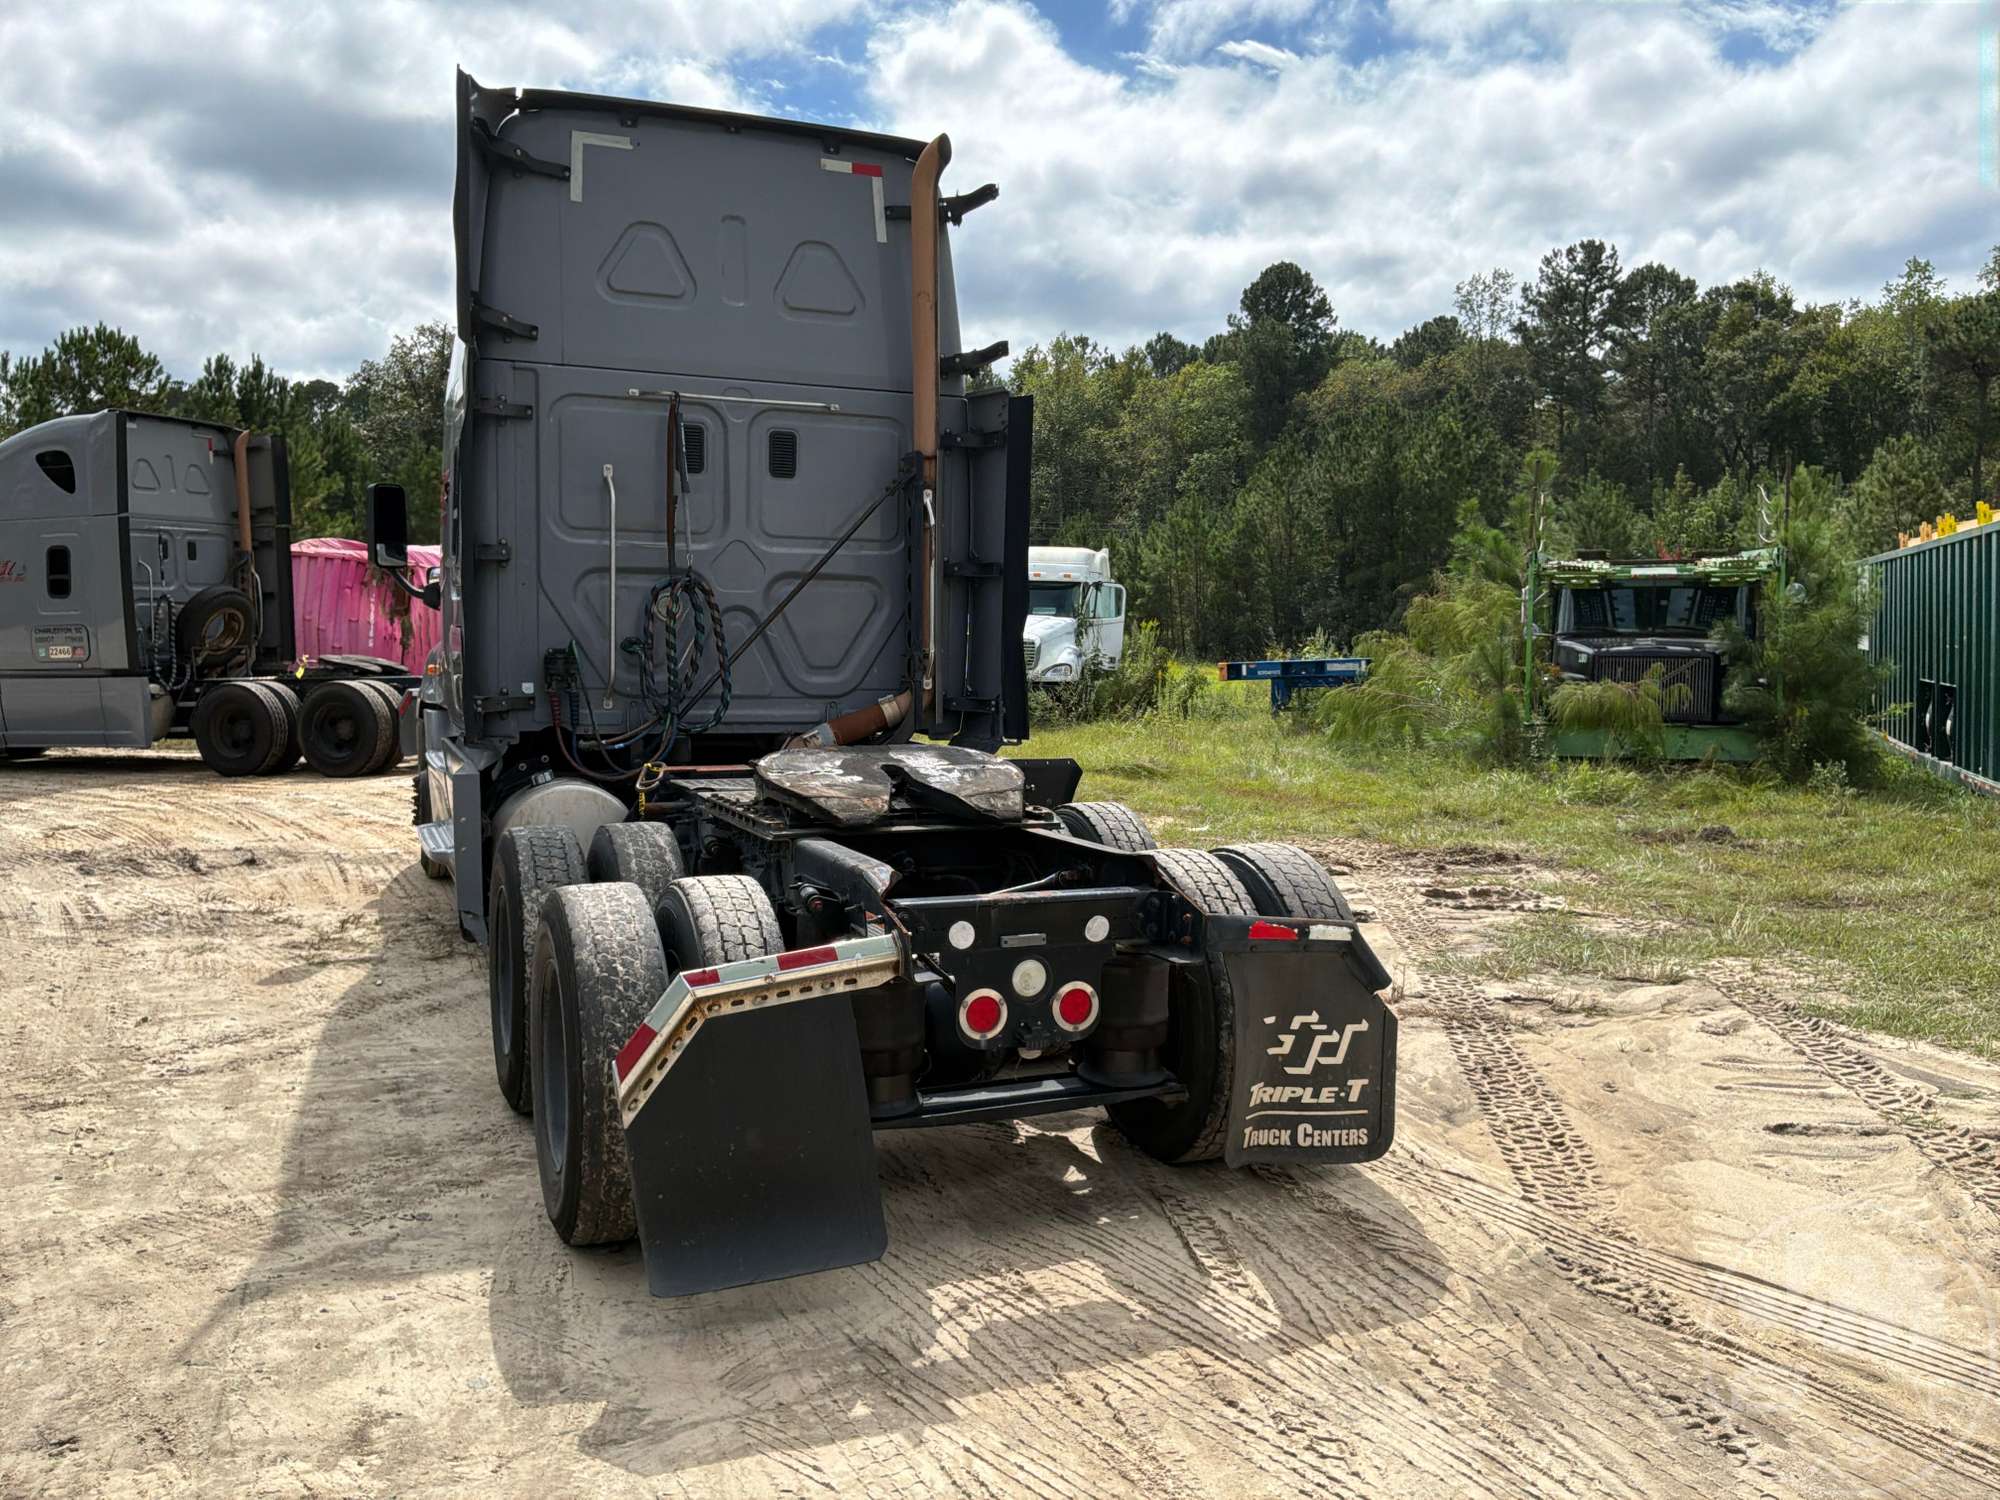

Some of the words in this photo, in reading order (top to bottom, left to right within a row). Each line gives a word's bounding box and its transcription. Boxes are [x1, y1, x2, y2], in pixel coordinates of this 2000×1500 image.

[49, 647, 71, 656] 22466
[1243, 1126, 1292, 1149] TRUCK
[1297, 1122, 1369, 1148] CENTERS
